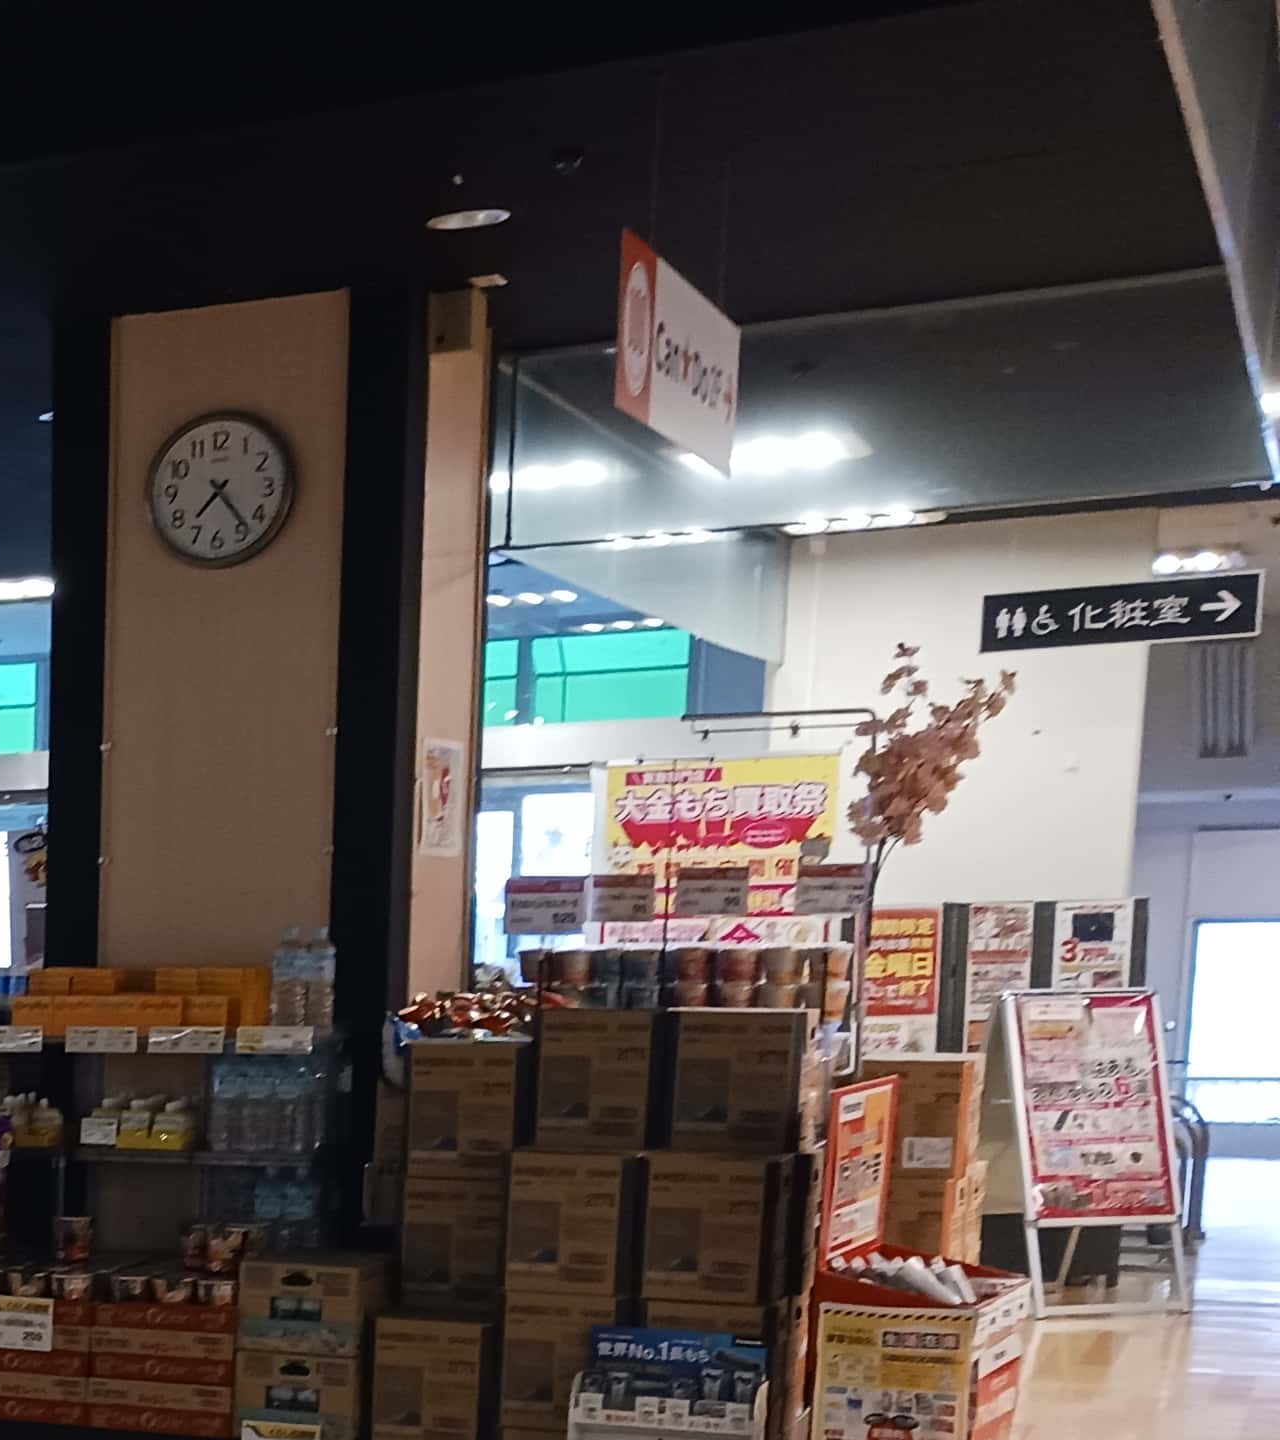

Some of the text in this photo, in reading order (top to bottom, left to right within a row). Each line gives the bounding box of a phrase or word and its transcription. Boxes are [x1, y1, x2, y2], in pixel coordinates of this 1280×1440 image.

[191, 439, 205, 459] 11
[213, 430, 230, 450] 12
[243, 433, 250, 454] 1
[171, 459, 190, 480] 10
[255, 452, 269, 472] 2
[164, 484, 179, 505] 9
[263, 477, 275, 498] 3
[171, 509, 185, 529] 8
[252, 504, 265, 524] 4
[190, 525, 202, 545] 7
[210, 528, 224, 549] 6
[1067, 595, 1191, 632] 化粧室
